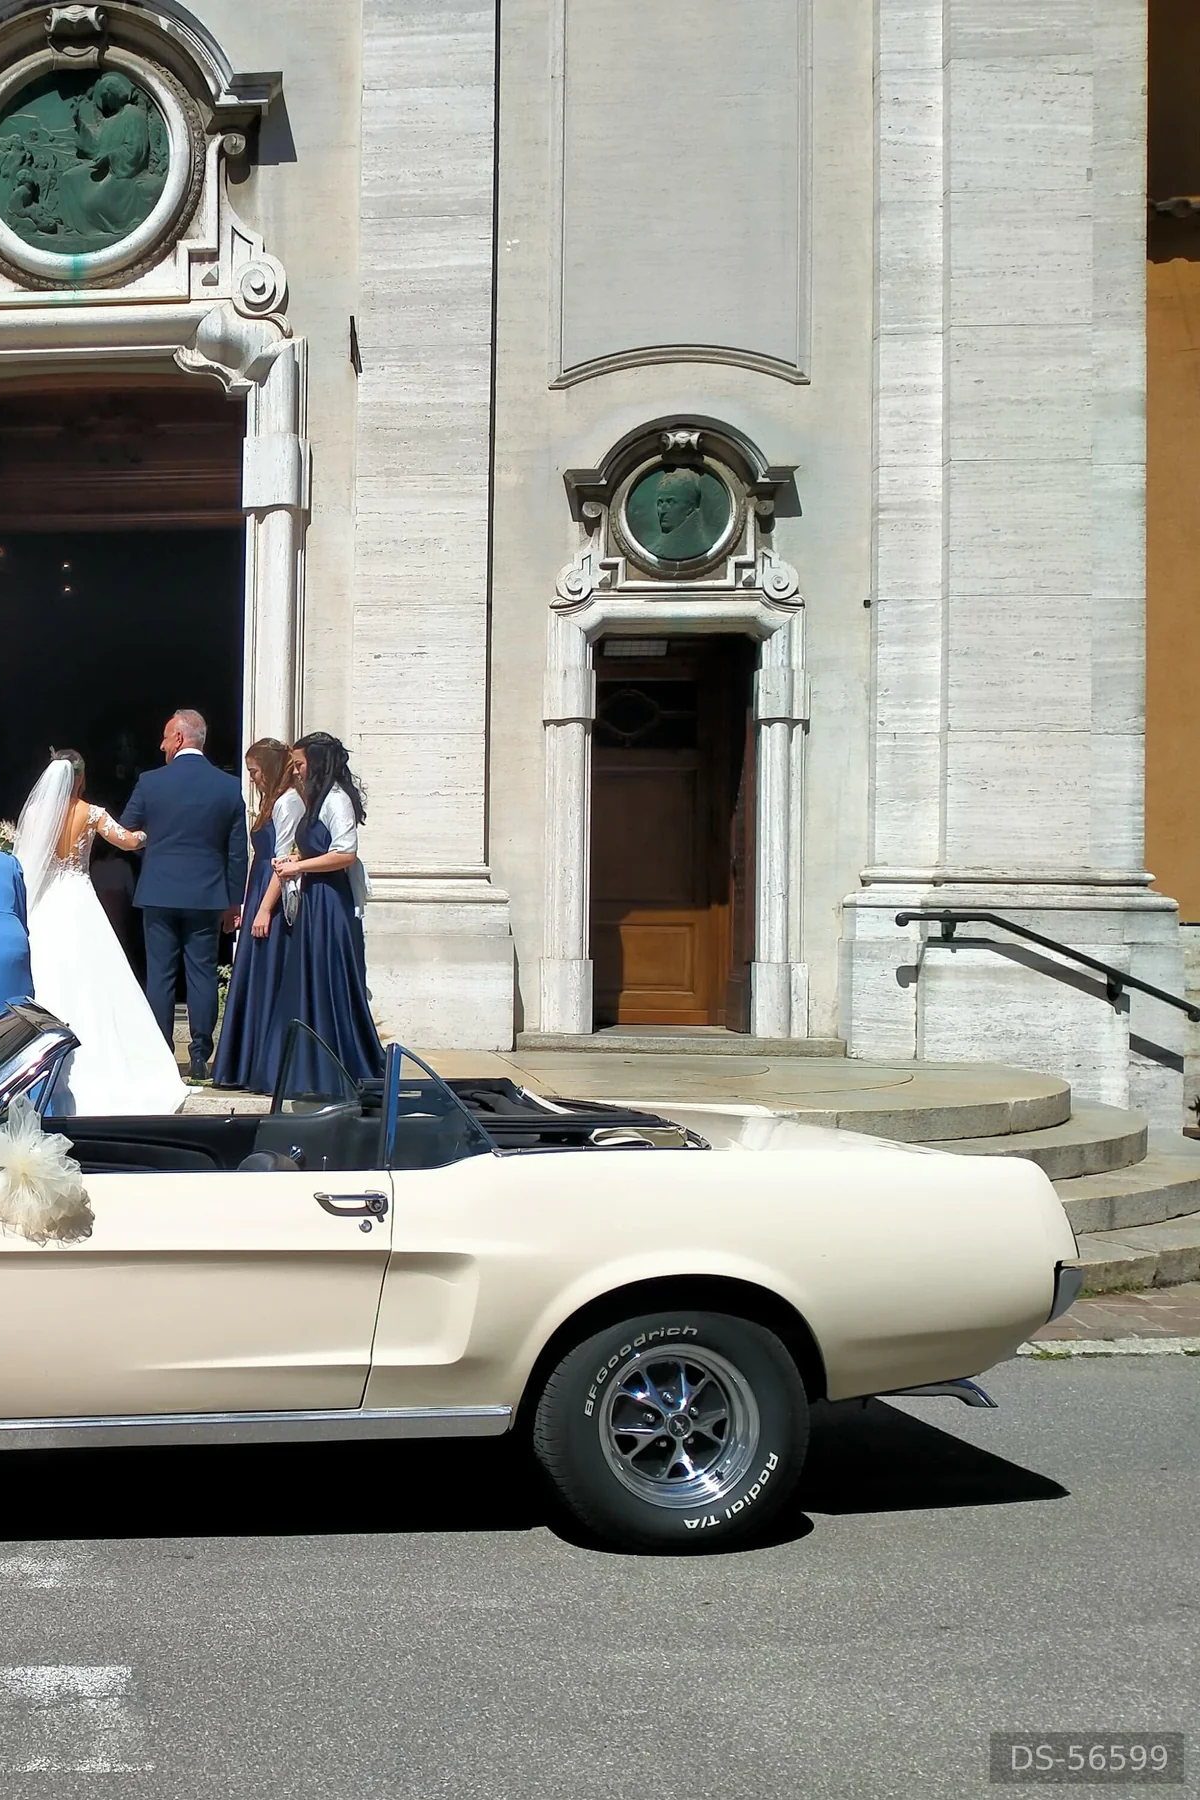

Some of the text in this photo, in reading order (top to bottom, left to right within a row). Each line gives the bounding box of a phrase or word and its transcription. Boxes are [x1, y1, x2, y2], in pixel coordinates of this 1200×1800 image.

[584, 1325, 698, 1417] BFGoodrich
[683, 1452, 779, 1529] Radial T/A
